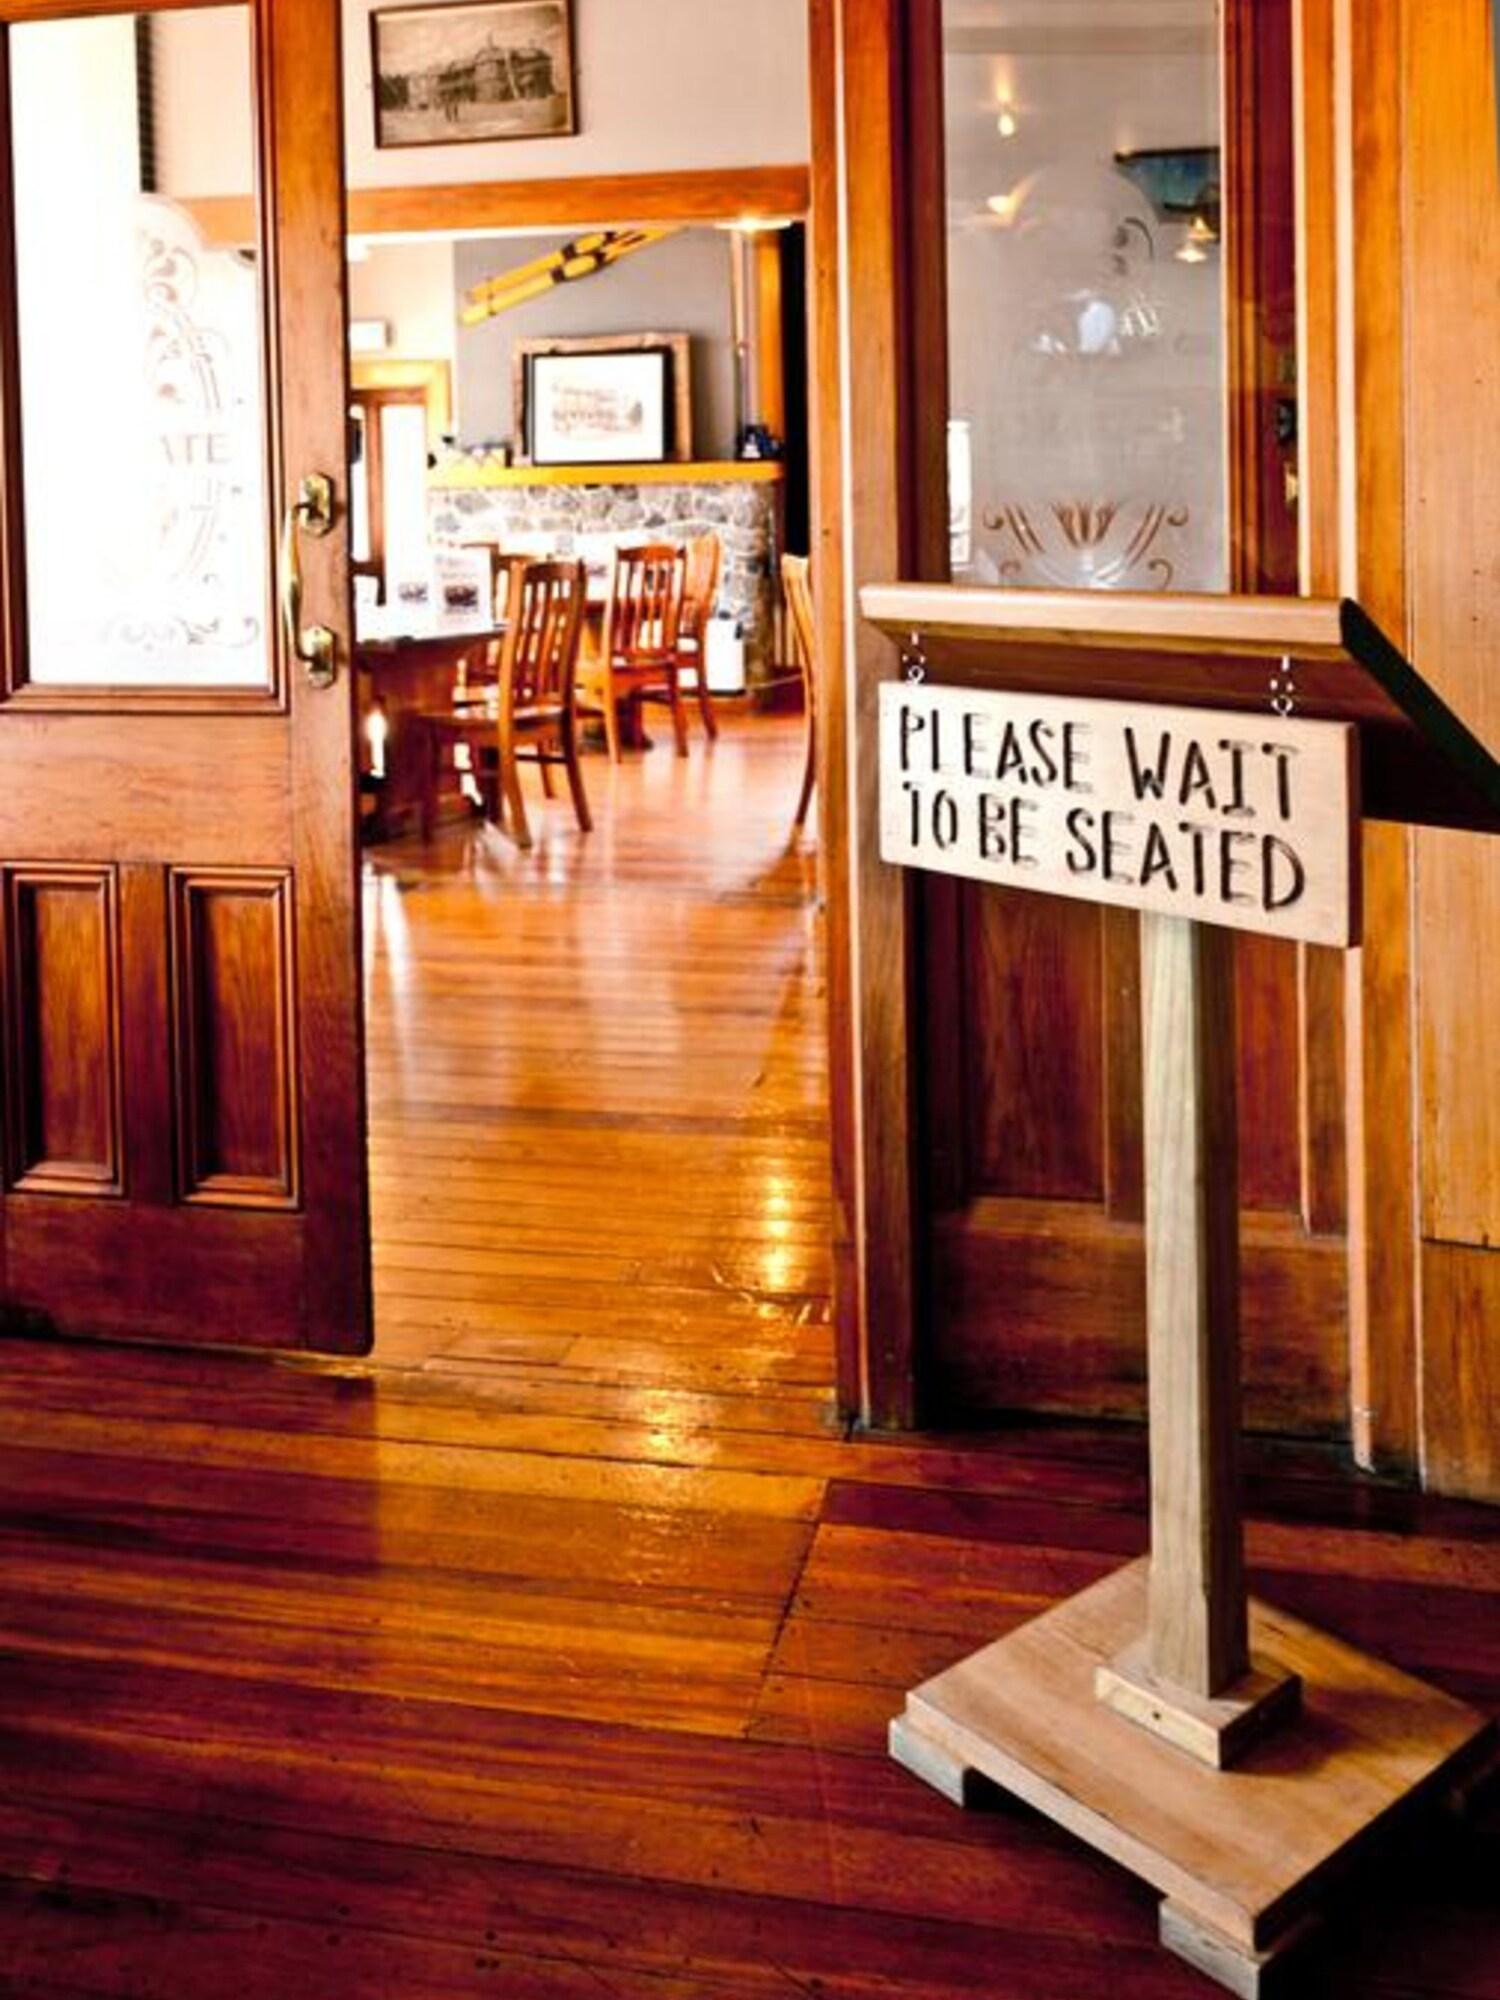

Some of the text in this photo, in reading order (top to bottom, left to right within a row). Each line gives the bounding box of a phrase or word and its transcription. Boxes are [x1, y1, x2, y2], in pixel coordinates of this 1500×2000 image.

[900, 705, 1300, 820] PLEASE WAIT
[902, 781, 1306, 912] TO BE SEATED
